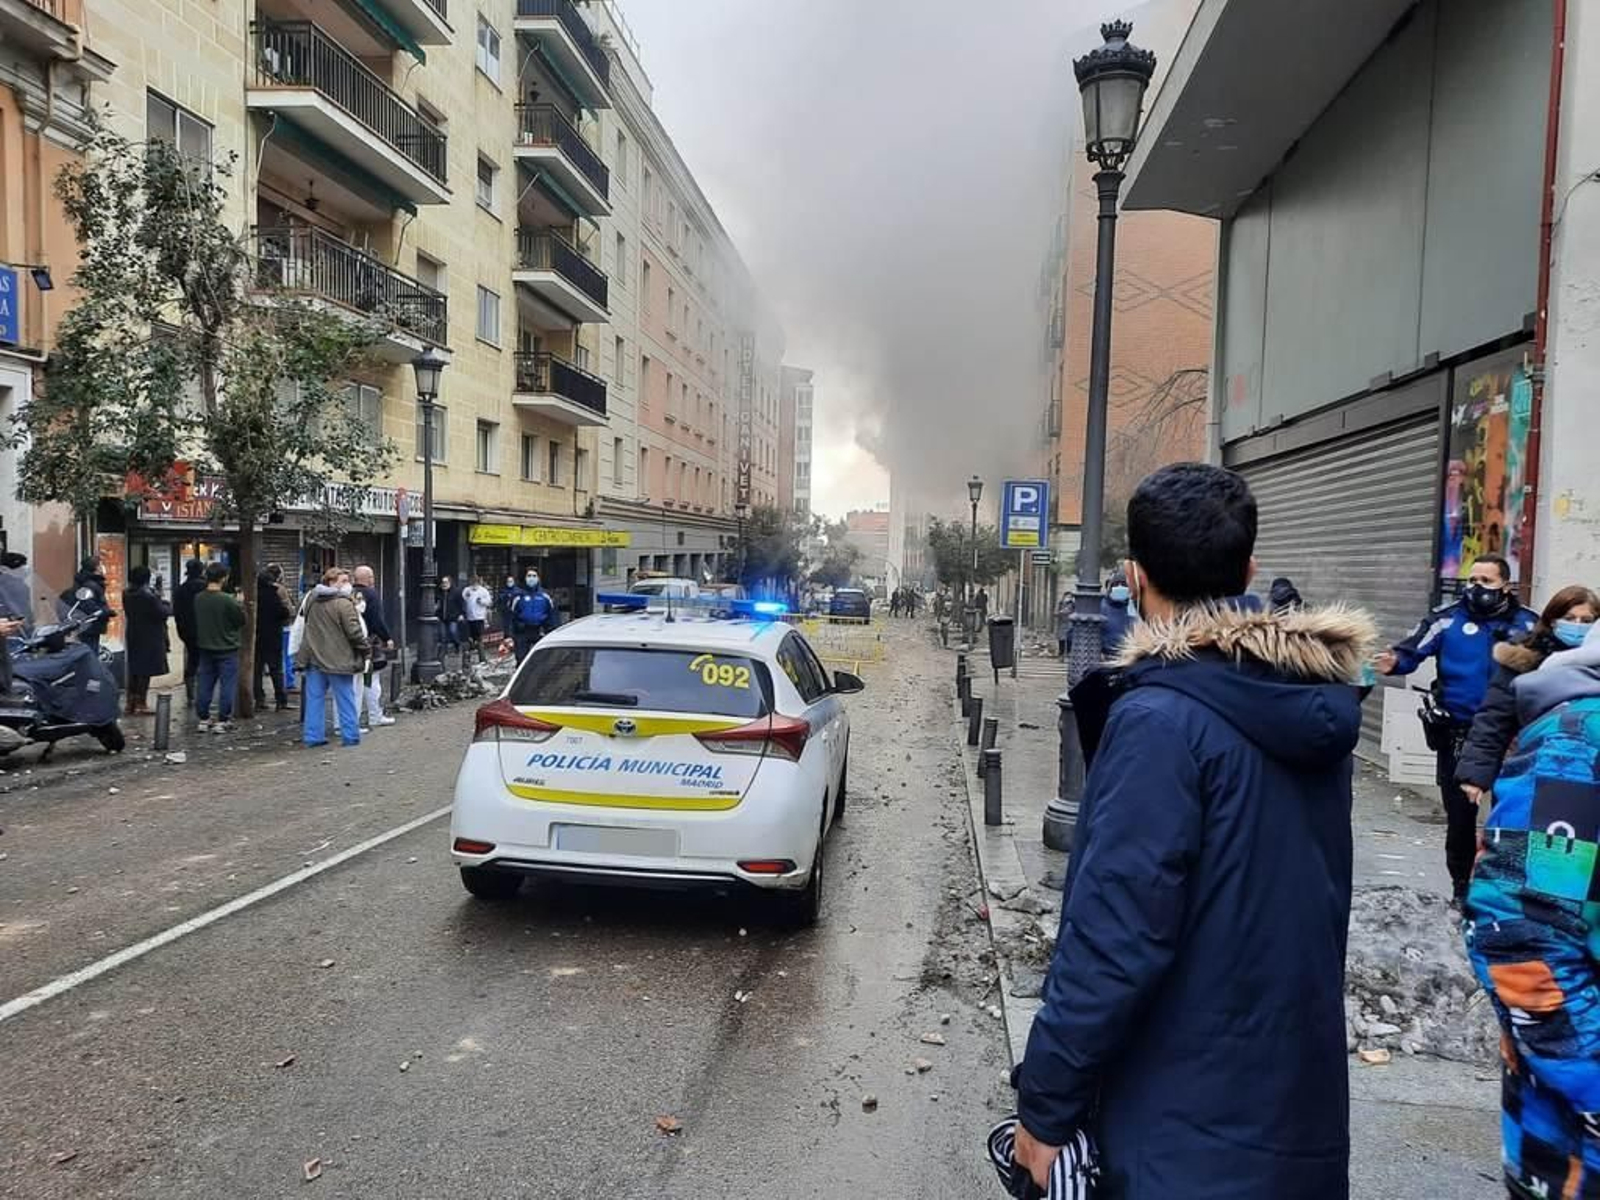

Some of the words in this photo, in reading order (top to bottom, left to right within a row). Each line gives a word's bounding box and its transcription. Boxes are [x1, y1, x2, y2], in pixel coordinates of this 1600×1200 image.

[1013, 486, 1038, 512] P
[702, 663, 750, 689] 092
[617, 759, 723, 779] MUNICIPAL
[680, 778, 724, 789] MADRID
